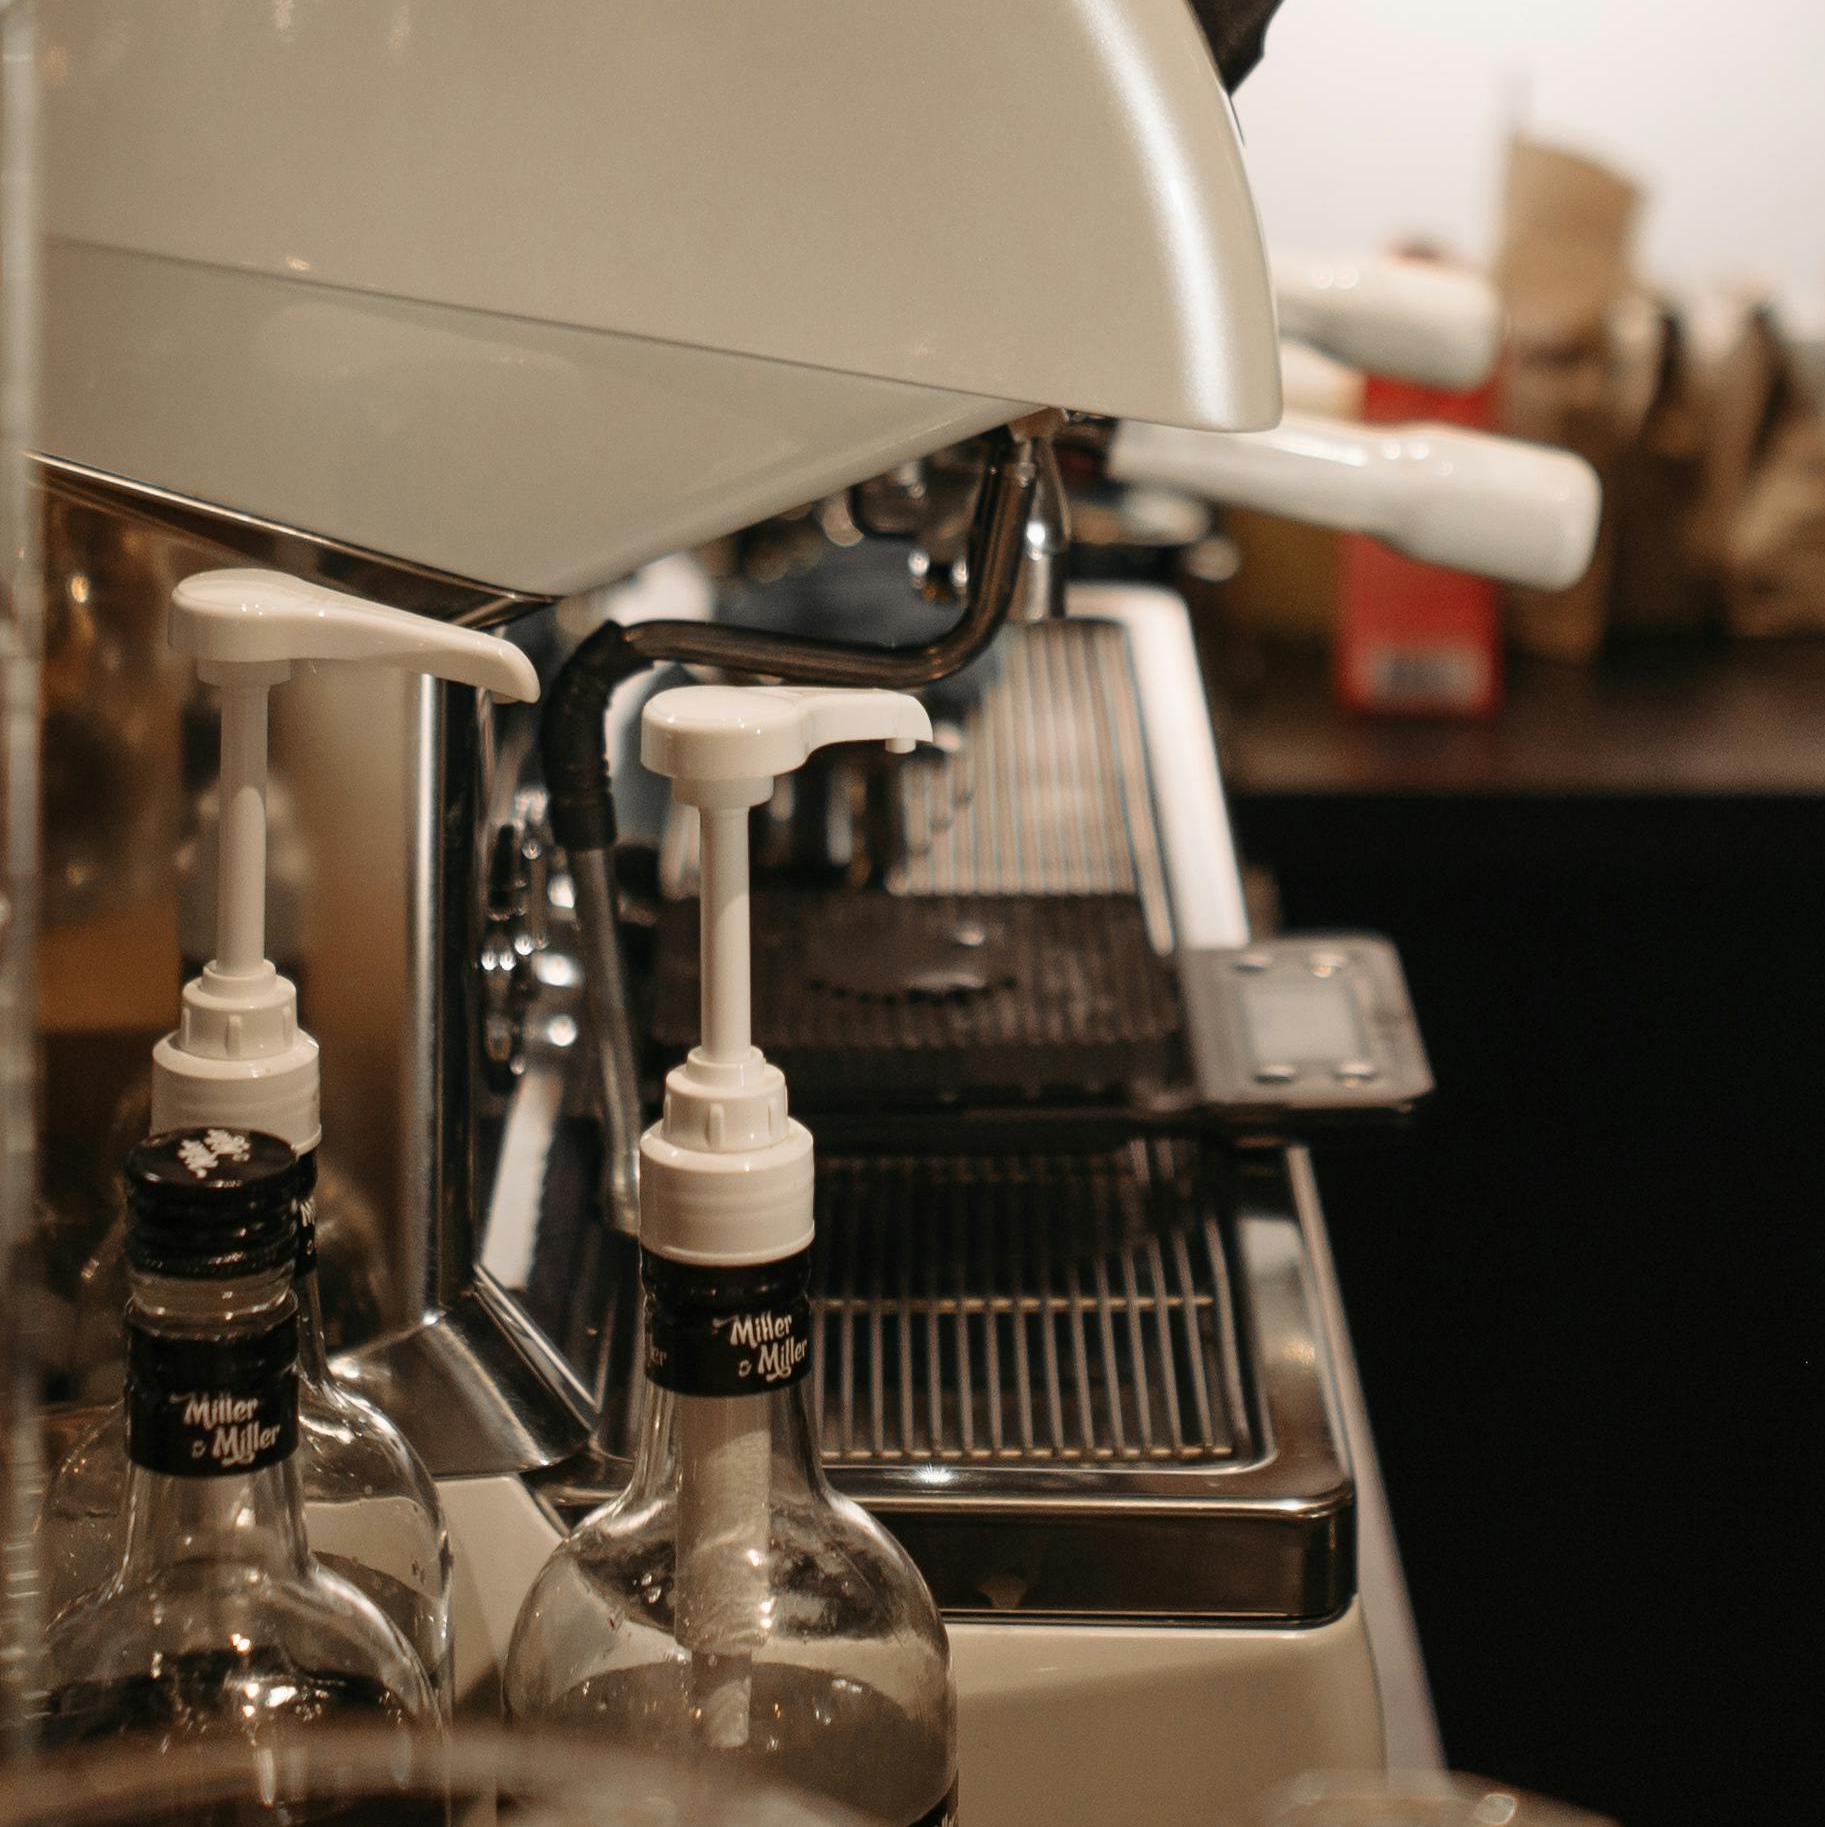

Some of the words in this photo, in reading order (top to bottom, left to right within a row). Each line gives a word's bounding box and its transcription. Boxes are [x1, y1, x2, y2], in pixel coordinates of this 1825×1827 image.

[713, 1310, 792, 1349] Miller
[757, 1336, 808, 1383] Miller
[170, 1392, 259, 1430] Miller
[212, 1421, 280, 1467] Miller
